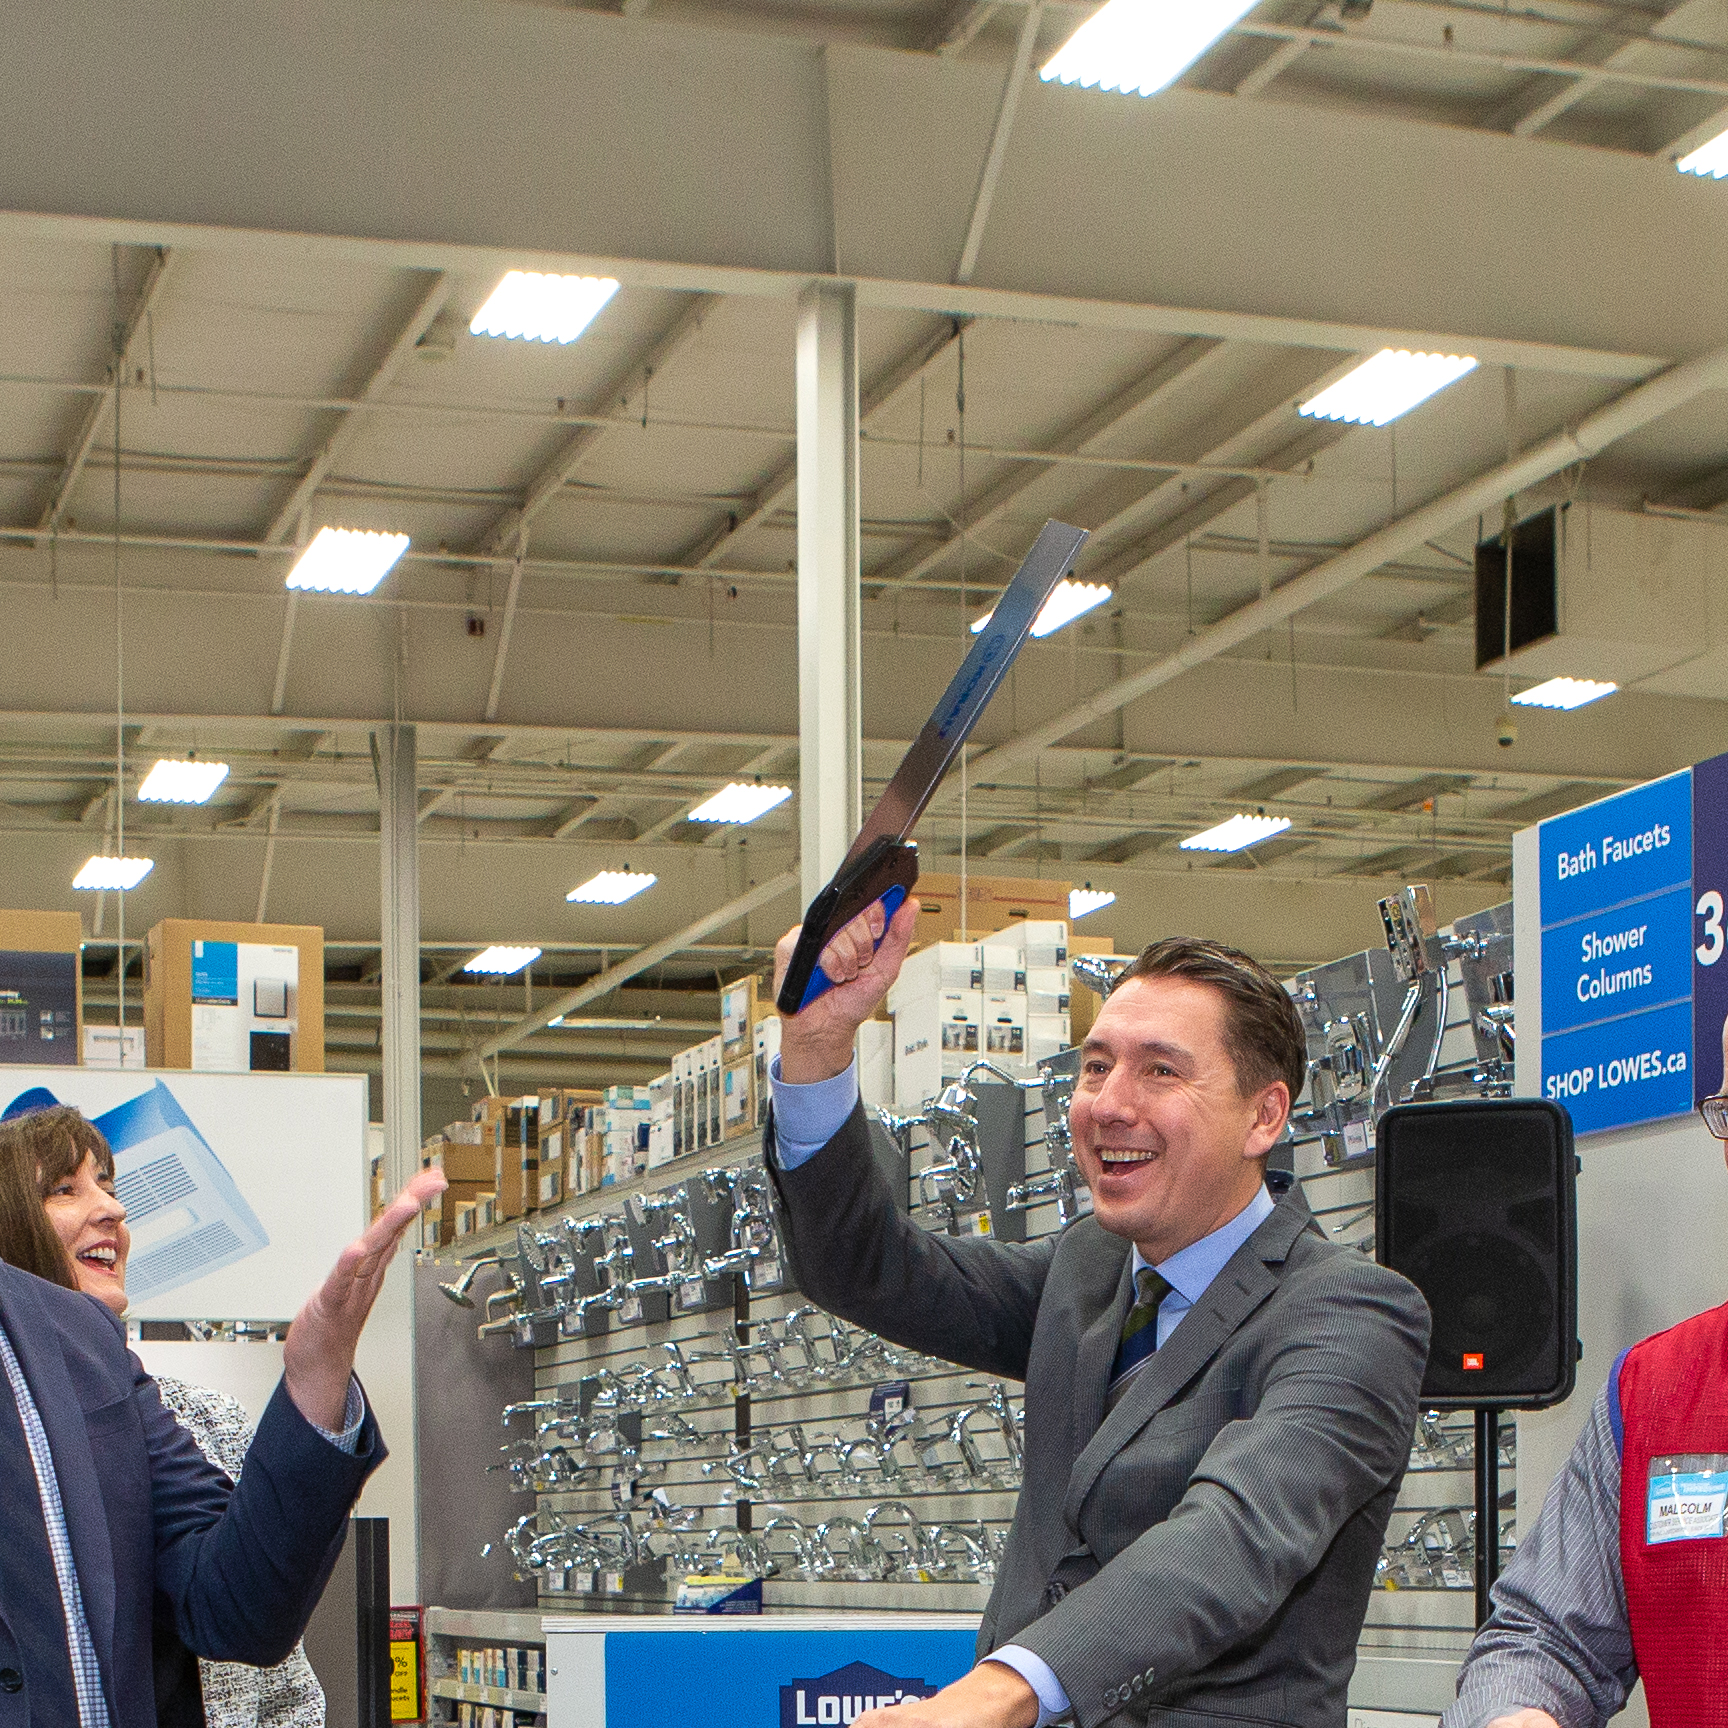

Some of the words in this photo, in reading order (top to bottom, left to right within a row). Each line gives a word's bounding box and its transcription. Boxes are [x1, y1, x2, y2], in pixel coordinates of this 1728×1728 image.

[1558, 843, 1597, 880] Bath
[1602, 824, 1671, 866] Faucets
[1581, 925, 1647, 963] Shower
[1577, 964, 1652, 1002] Columns
[1546, 1067, 1594, 1100] SHOP
[1598, 1050, 1686, 1089] LOWES.ca
[1659, 1502, 1712, 1517] MALCOLM
